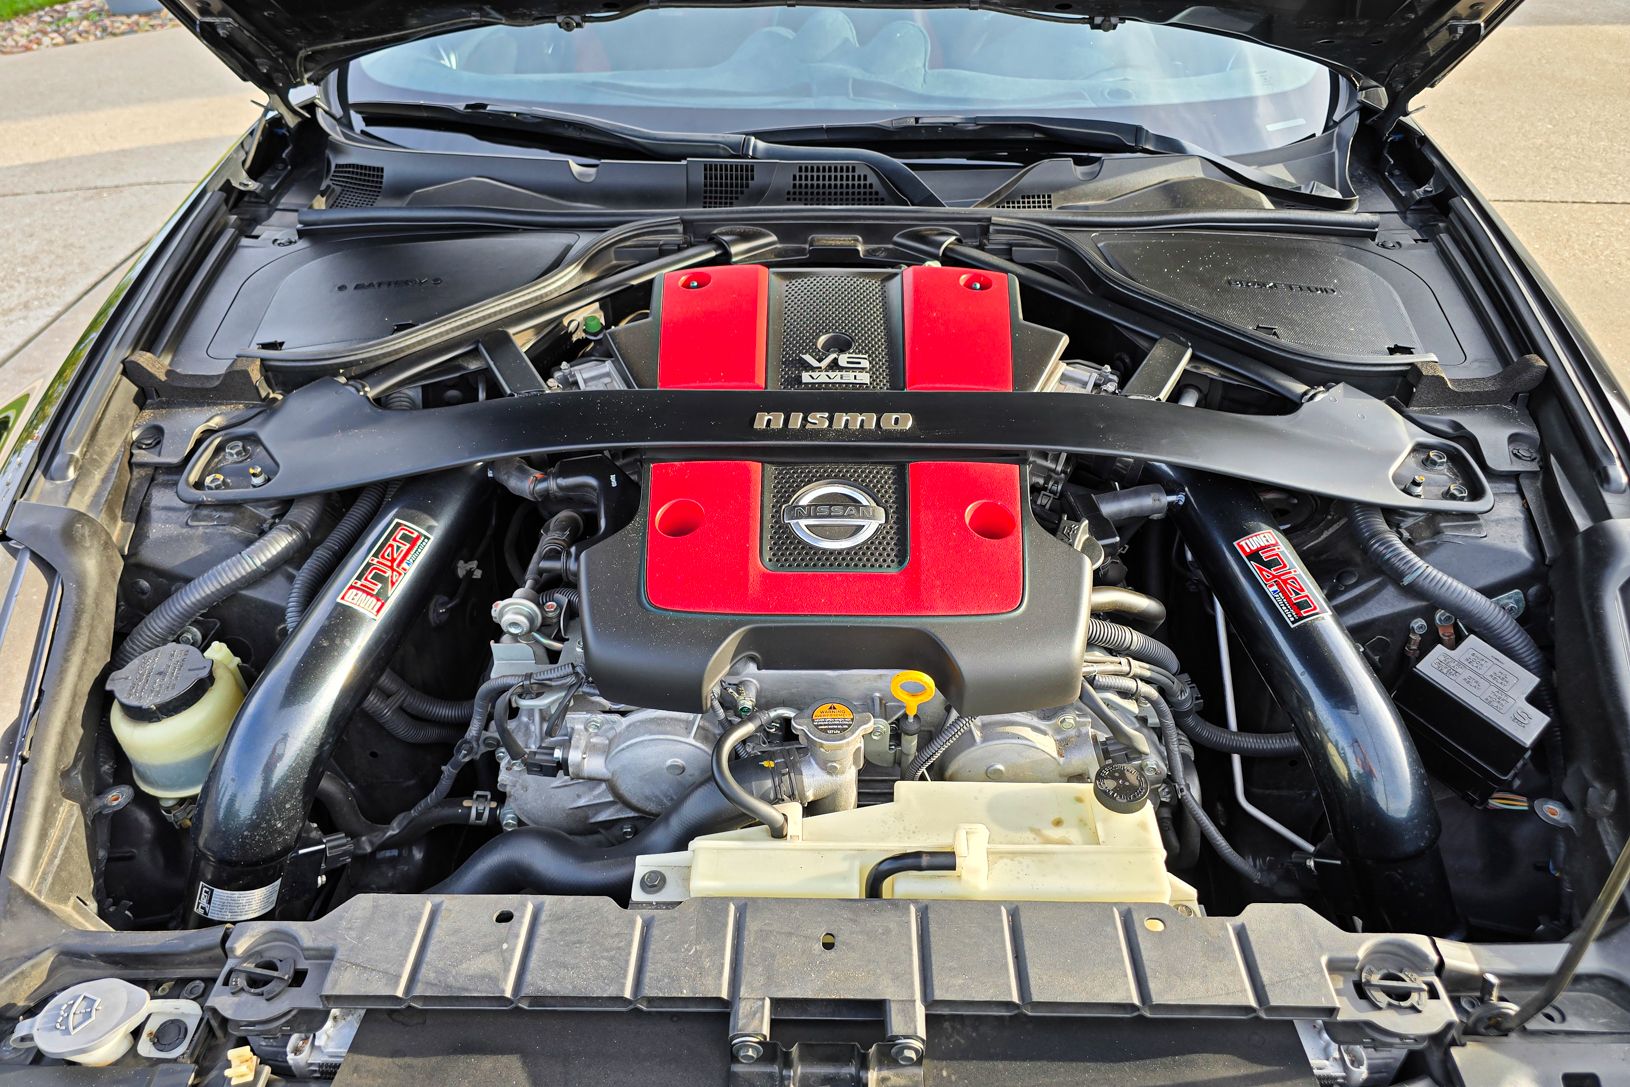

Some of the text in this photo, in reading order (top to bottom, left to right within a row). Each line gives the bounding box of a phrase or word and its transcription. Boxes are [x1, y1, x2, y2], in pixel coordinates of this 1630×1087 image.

[353, 278, 427, 290] BATTERY
[800, 353, 869, 370] V6
[808, 373, 864, 381] VVEL
[754, 412, 913, 430] nismo
[794, 505, 873, 518] NISSAN
[1240, 533, 1276, 552] TUNED
[1250, 546, 1319, 616] injen
[346, 589, 382, 616] TUNED
